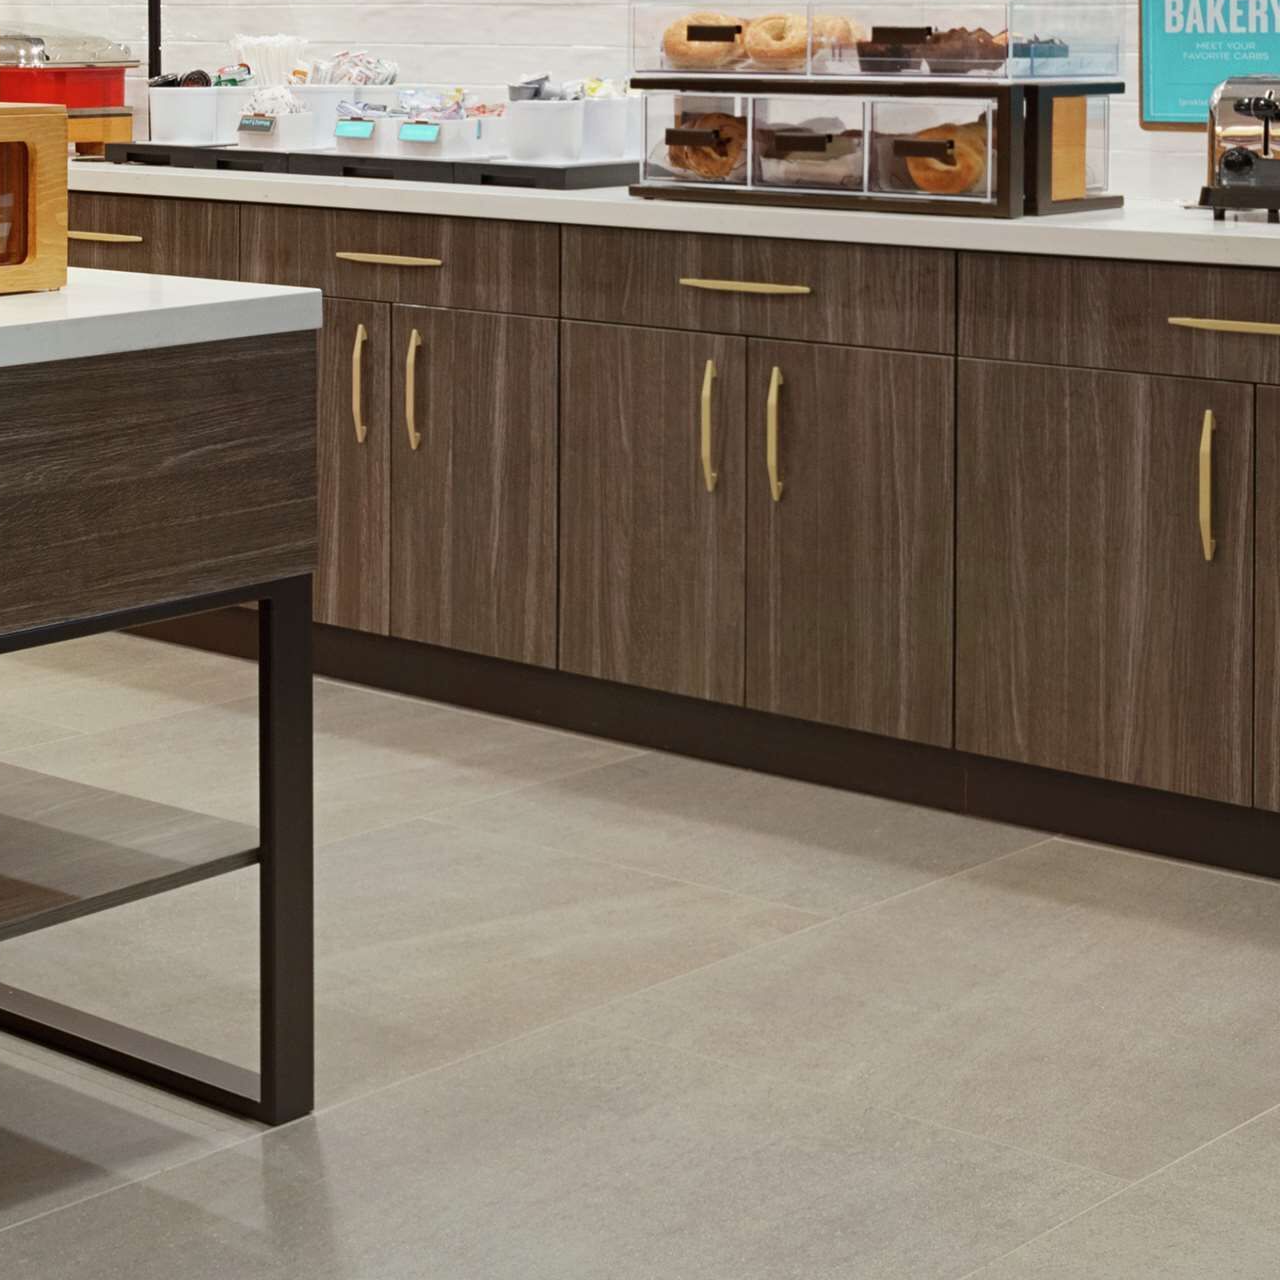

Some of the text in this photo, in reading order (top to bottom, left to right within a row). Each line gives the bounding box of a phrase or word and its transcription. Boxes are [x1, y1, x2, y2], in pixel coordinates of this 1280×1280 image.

[1196, 41, 1256, 50] MEET YOUR
[1183, 51, 1269, 60] FAVORITE CARBS
